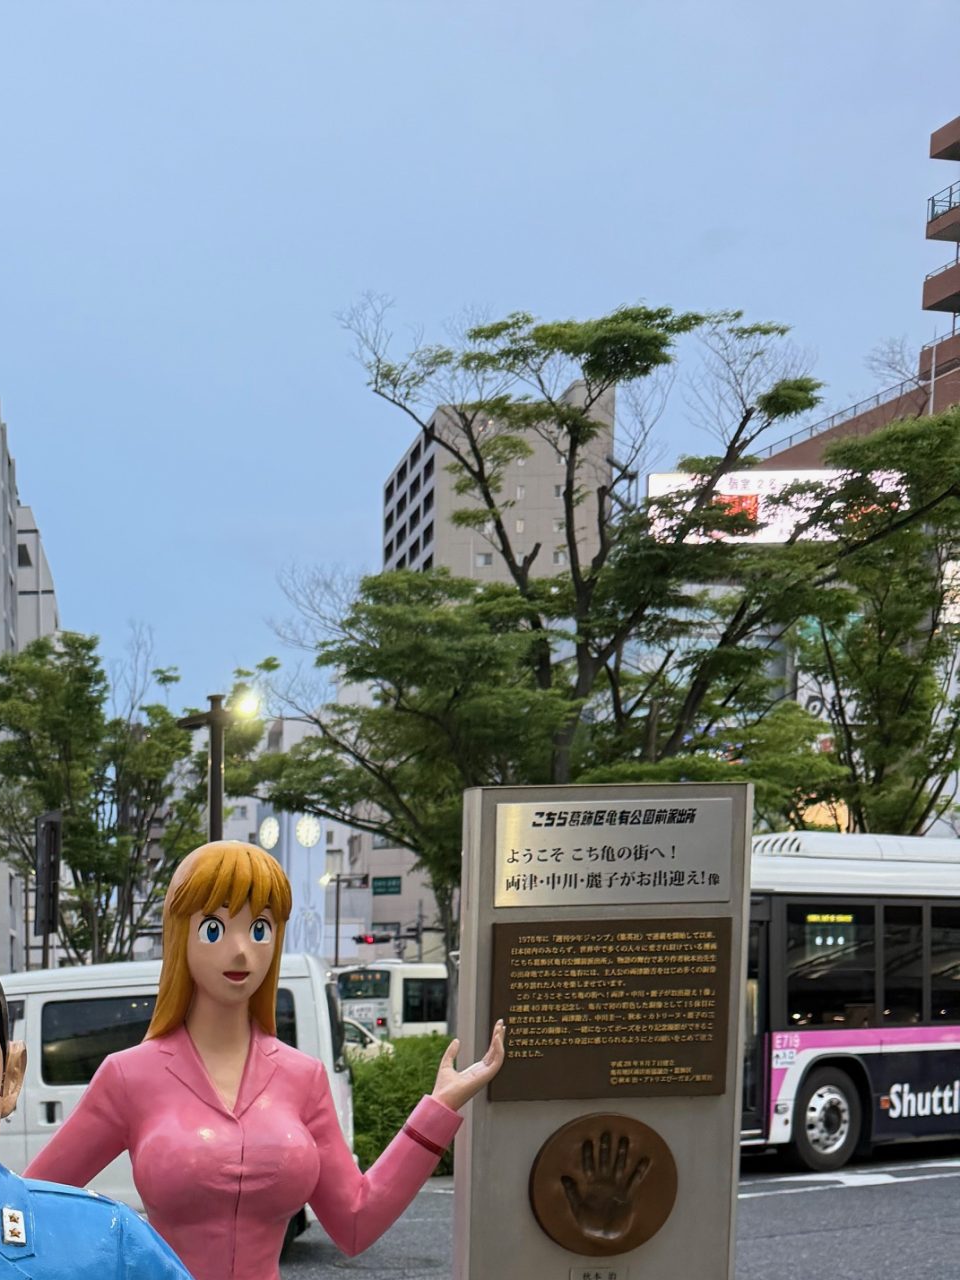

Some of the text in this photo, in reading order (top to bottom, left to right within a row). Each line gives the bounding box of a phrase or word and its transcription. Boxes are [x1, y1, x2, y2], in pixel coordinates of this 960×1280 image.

[532, 808, 697, 828] こちら葛飾区亀有公園前派出所
[506, 848, 564, 864] ようこそ
[888, 1080, 960, 1118] Shuttl
